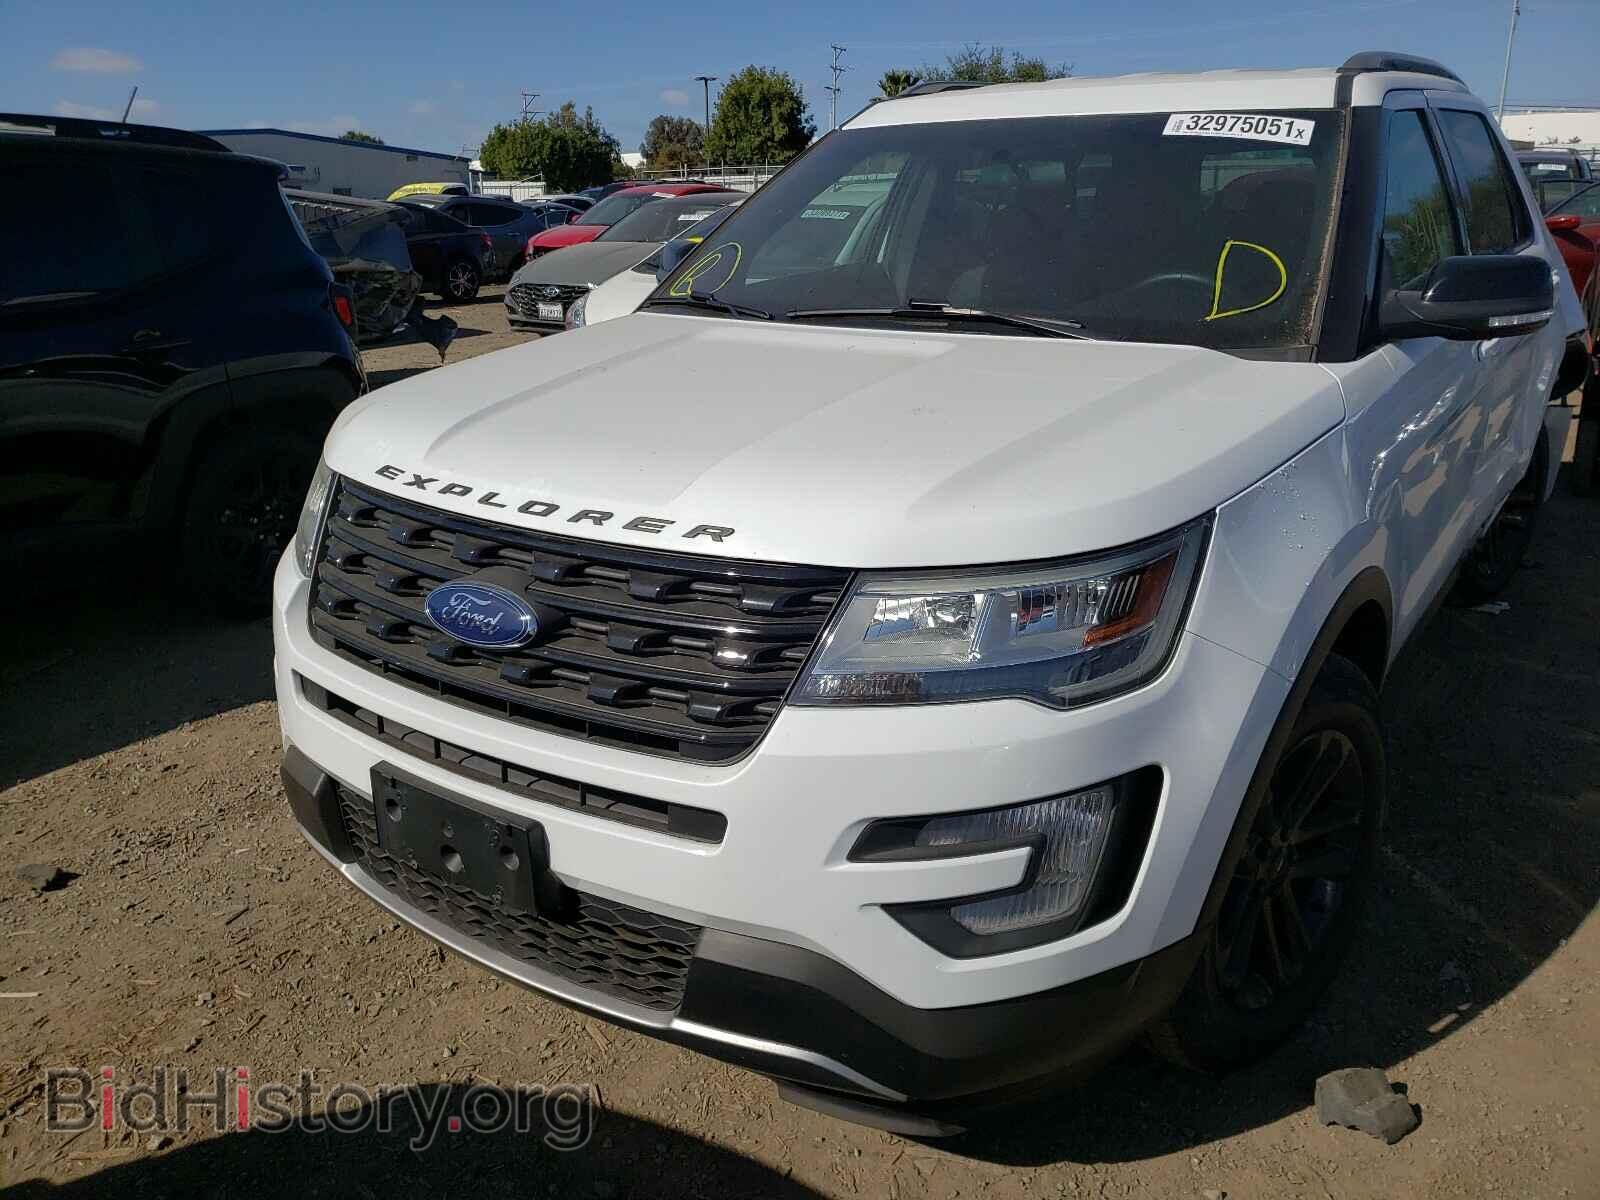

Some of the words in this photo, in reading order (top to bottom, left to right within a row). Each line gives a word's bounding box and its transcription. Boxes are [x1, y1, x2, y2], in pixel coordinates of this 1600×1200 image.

[1204, 239, 1287, 320] D
[375, 464, 735, 543] EXPLORER
[441, 592, 504, 636] Ford
